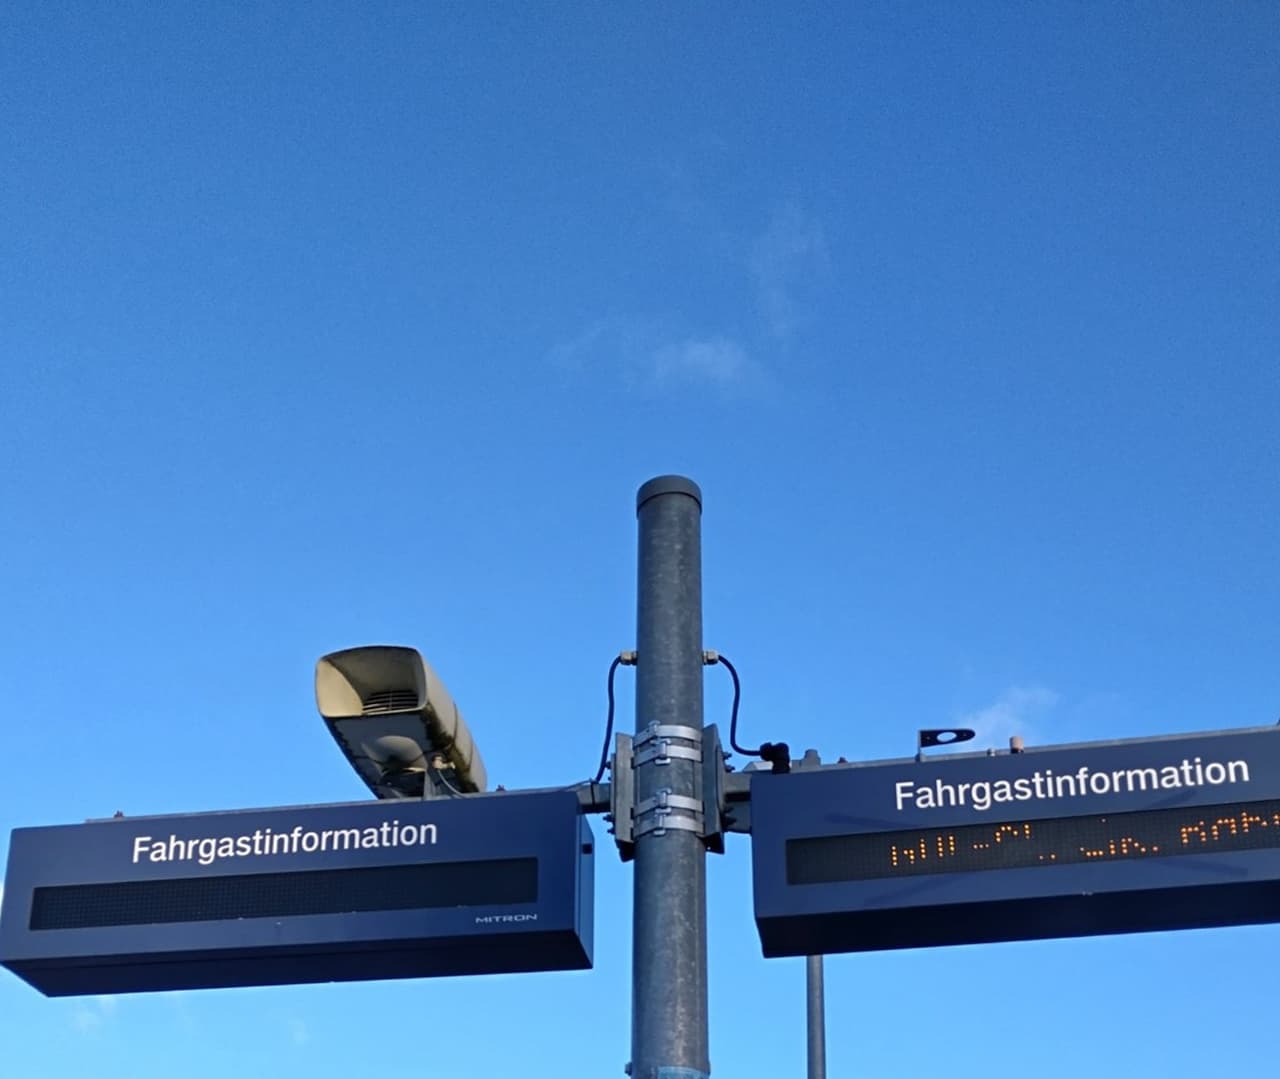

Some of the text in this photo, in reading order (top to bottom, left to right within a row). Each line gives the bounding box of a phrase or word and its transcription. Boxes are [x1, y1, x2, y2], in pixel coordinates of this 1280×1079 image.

[894, 757, 1251, 811] Fahrgastinformation
[132, 820, 438, 865] Fahrgastinformation
[475, 913, 538, 924] MITRON
